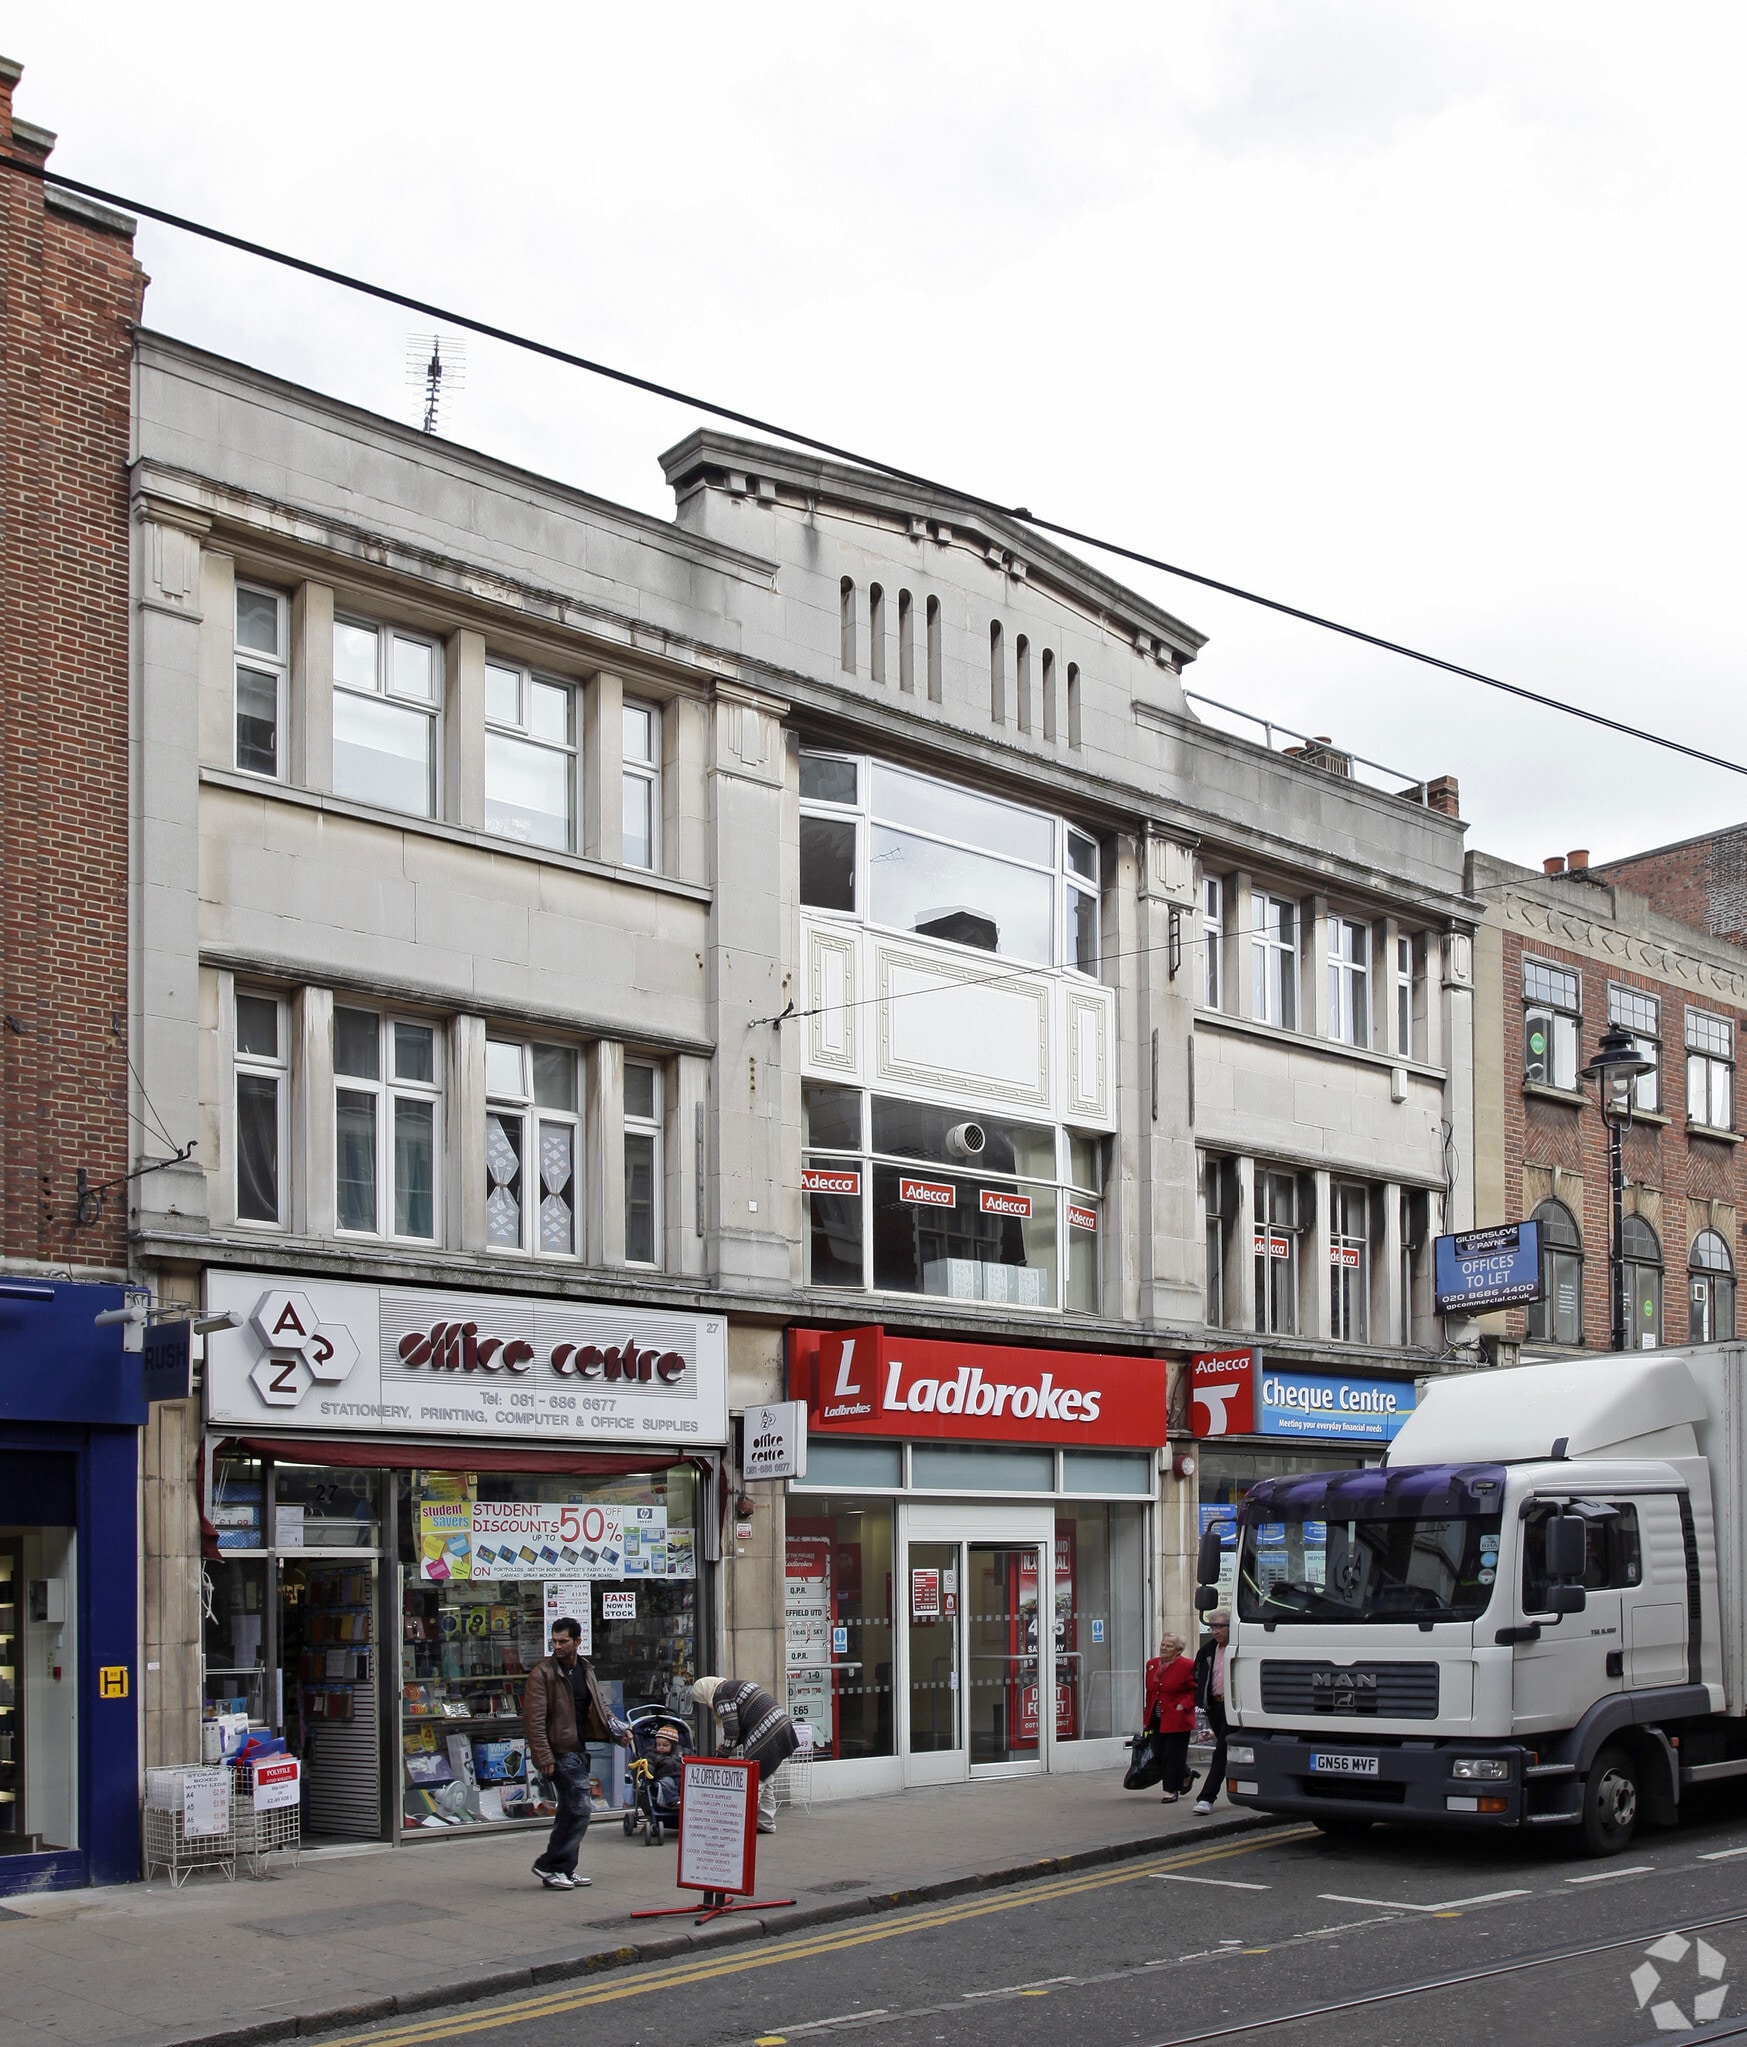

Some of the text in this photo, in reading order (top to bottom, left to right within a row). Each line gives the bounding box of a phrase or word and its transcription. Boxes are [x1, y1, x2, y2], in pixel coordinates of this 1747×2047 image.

[801, 1173, 853, 1191] Adecco
[906, 1184, 950, 1203] Adecco
[985, 1196, 1027, 1214] Adecco
[1068, 1208, 1095, 1227] Adecco
[1456, 1227, 1518, 1244] GILDERSLEVE
[1477, 1238, 1507, 1249] PAYNE
[1462, 1255, 1514, 1274] OFFICES
[1466, 1271, 1510, 1289] TO LET
[1442, 1284, 1535, 1303] 020 8686 4400
[1446, 1293, 1530, 1310] gpcommercial.co.uk
[272, 1301, 307, 1337] A
[706, 1323, 720, 1334] 27
[144, 1342, 187, 1371] RUSH
[398, 1321, 686, 1383] office centre
[834, 1339, 861, 1397] L
[1195, 1358, 1250, 1375] Adecco
[270, 1360, 297, 1393] Z
[883, 1361, 1102, 1423] Ladbrokes
[1263, 1377, 1397, 1414] Cheque Centre
[480, 1392, 502, 1406] Tel:
[583, 1398, 618, 1412] 6677
[824, 1402, 871, 1418] Ladbrokes
[321, 1401, 699, 1433] STATIONERY, PRINTING, COMPUTER & OFFICE SUPPLIES
[1279, 1419, 1383, 1433] Meeting your everyday financial needs
[753, 1433, 784, 1449] office
[751, 1448, 785, 1463] centre
[316, 1484, 339, 1501] 27
[422, 1504, 463, 1518] student
[473, 1504, 543, 1517] STUDENT
[606, 1508, 622, 1516] OFF
[433, 1517, 469, 1528] savers
[473, 1520, 560, 1533] DISCOUNTS
[473, 1567, 491, 1577] ON
[605, 1594, 634, 1602] FANS
[104, 1670, 124, 1695] H
[808, 1671, 820, 1679] 1-0
[1312, 1673, 1377, 1688] MAN
[793, 1706, 809, 1715] £65
[267, 1766, 291, 1776] POLYFILE
[1318, 1756, 1376, 1771] GN56 MVF
[690, 1768, 744, 1788] A-Z OFFICE CENTRE
